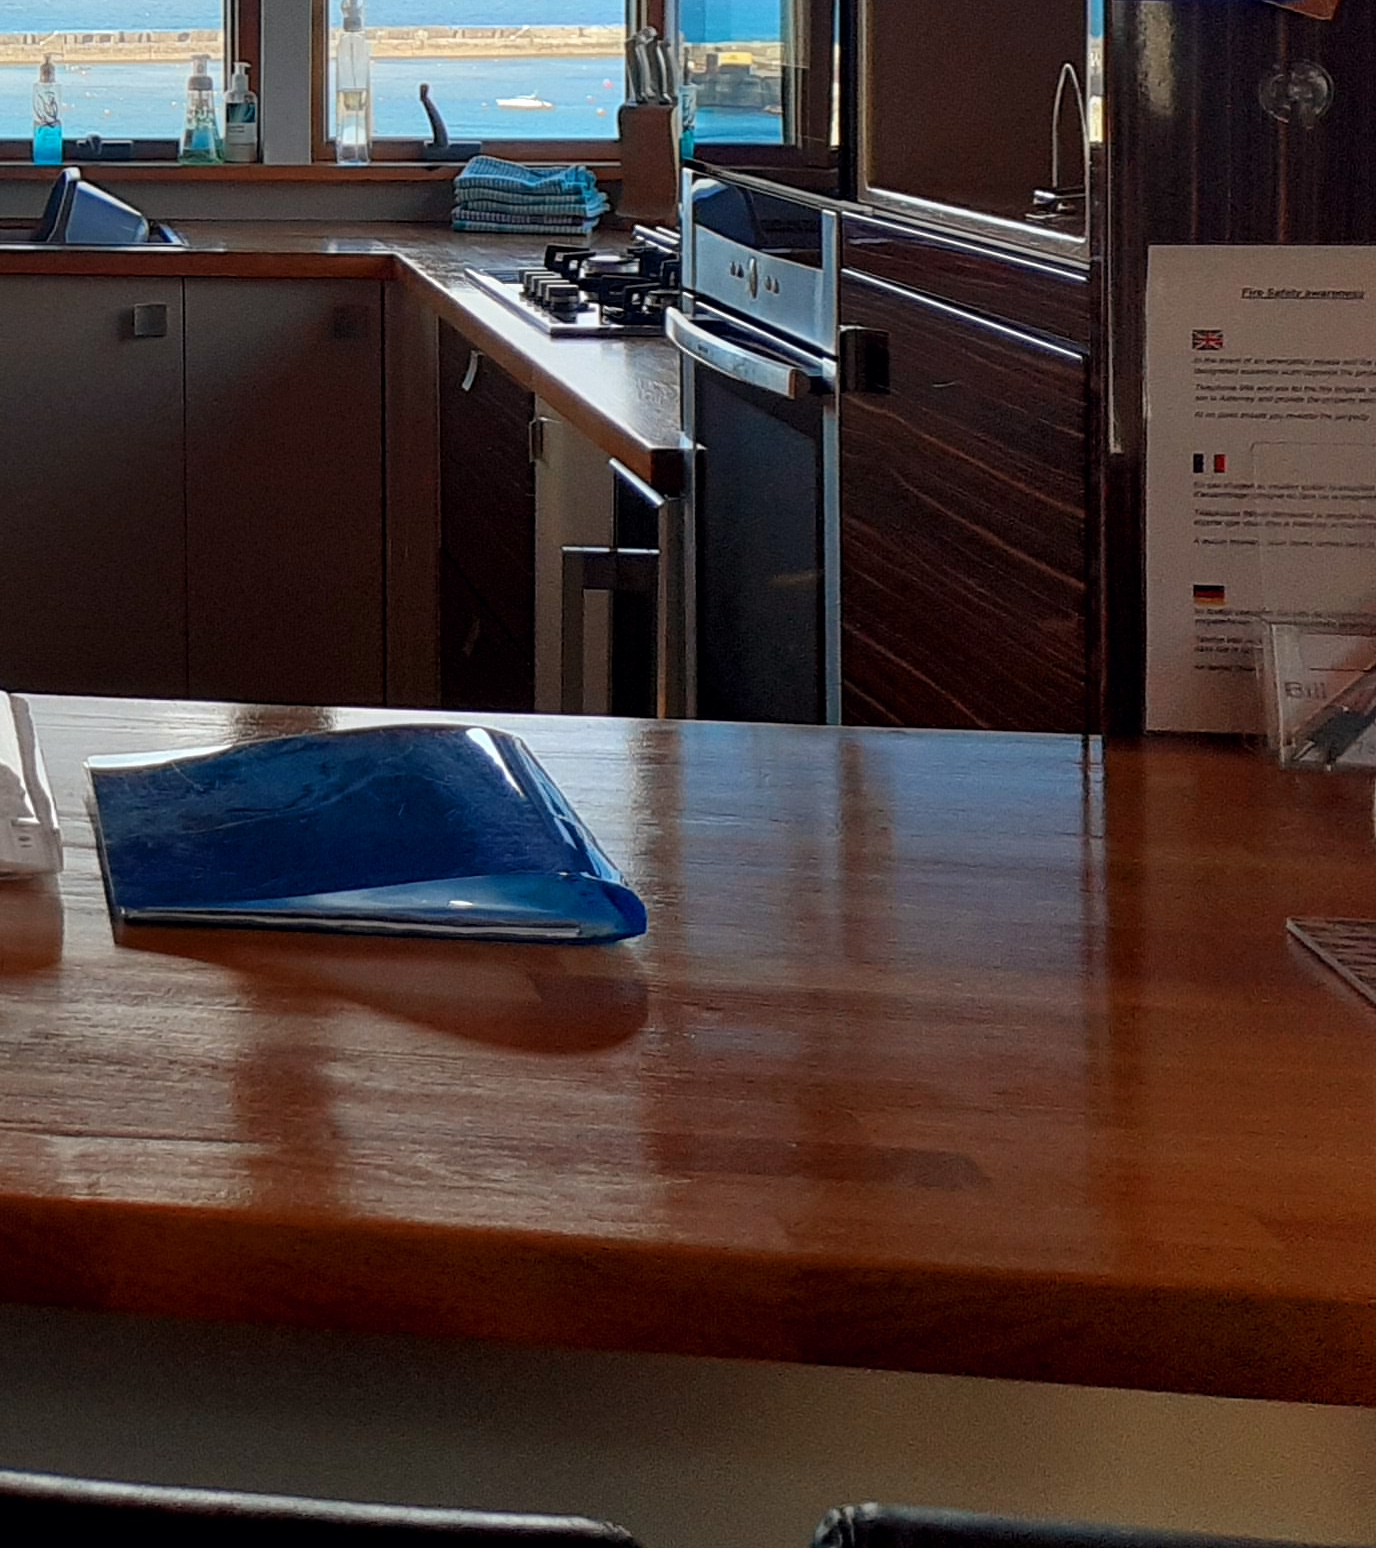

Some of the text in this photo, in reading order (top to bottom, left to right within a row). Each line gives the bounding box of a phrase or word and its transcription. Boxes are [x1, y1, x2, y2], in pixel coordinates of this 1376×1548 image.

[1241, 287, 1265, 299] Fire
[1267, 287, 1303, 300] Safety
[1284, 681, 1327, 700] Bill
